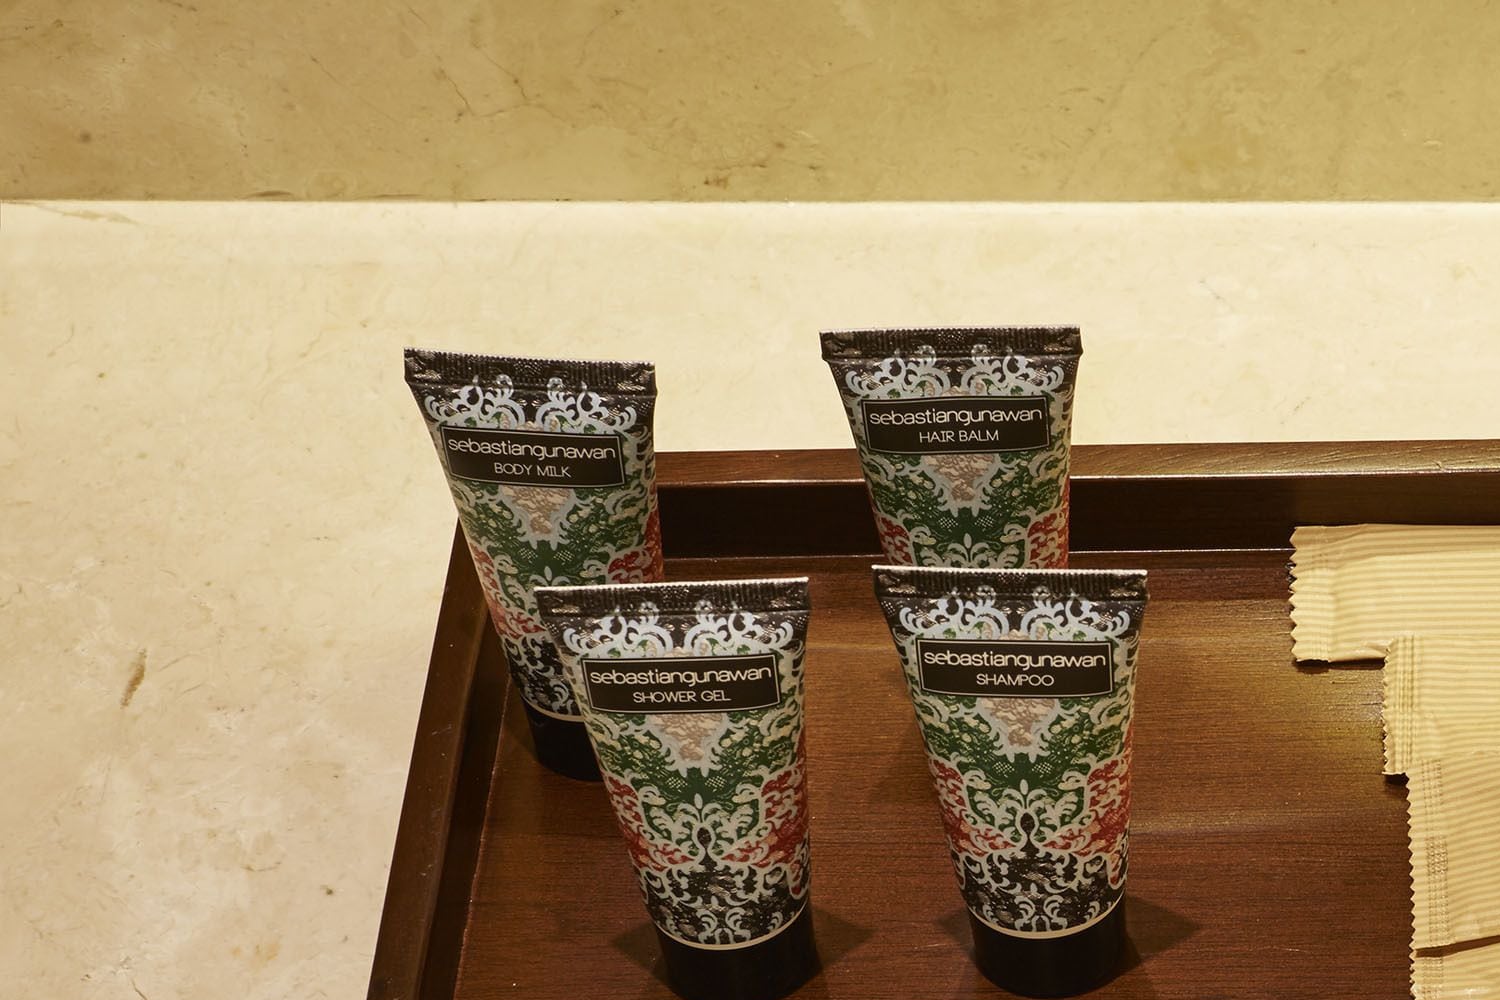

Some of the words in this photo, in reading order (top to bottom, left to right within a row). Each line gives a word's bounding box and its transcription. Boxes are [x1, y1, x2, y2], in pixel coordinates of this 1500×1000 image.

[869, 408, 1042, 426] sebastiangunawan
[919, 430, 955, 443] HAIR
[958, 429, 999, 442] BALM
[447, 438, 616, 460] sebastiangunawan
[493, 462, 533, 476] BODY
[536, 465, 572, 478] MILK
[923, 649, 1106, 671] sebastiangunawan
[590, 667, 772, 688] sebastiangunawan
[976, 673, 1055, 687] SHAMPOO
[632, 690, 697, 703] SHOWER
[700, 689, 732, 702] GEL
